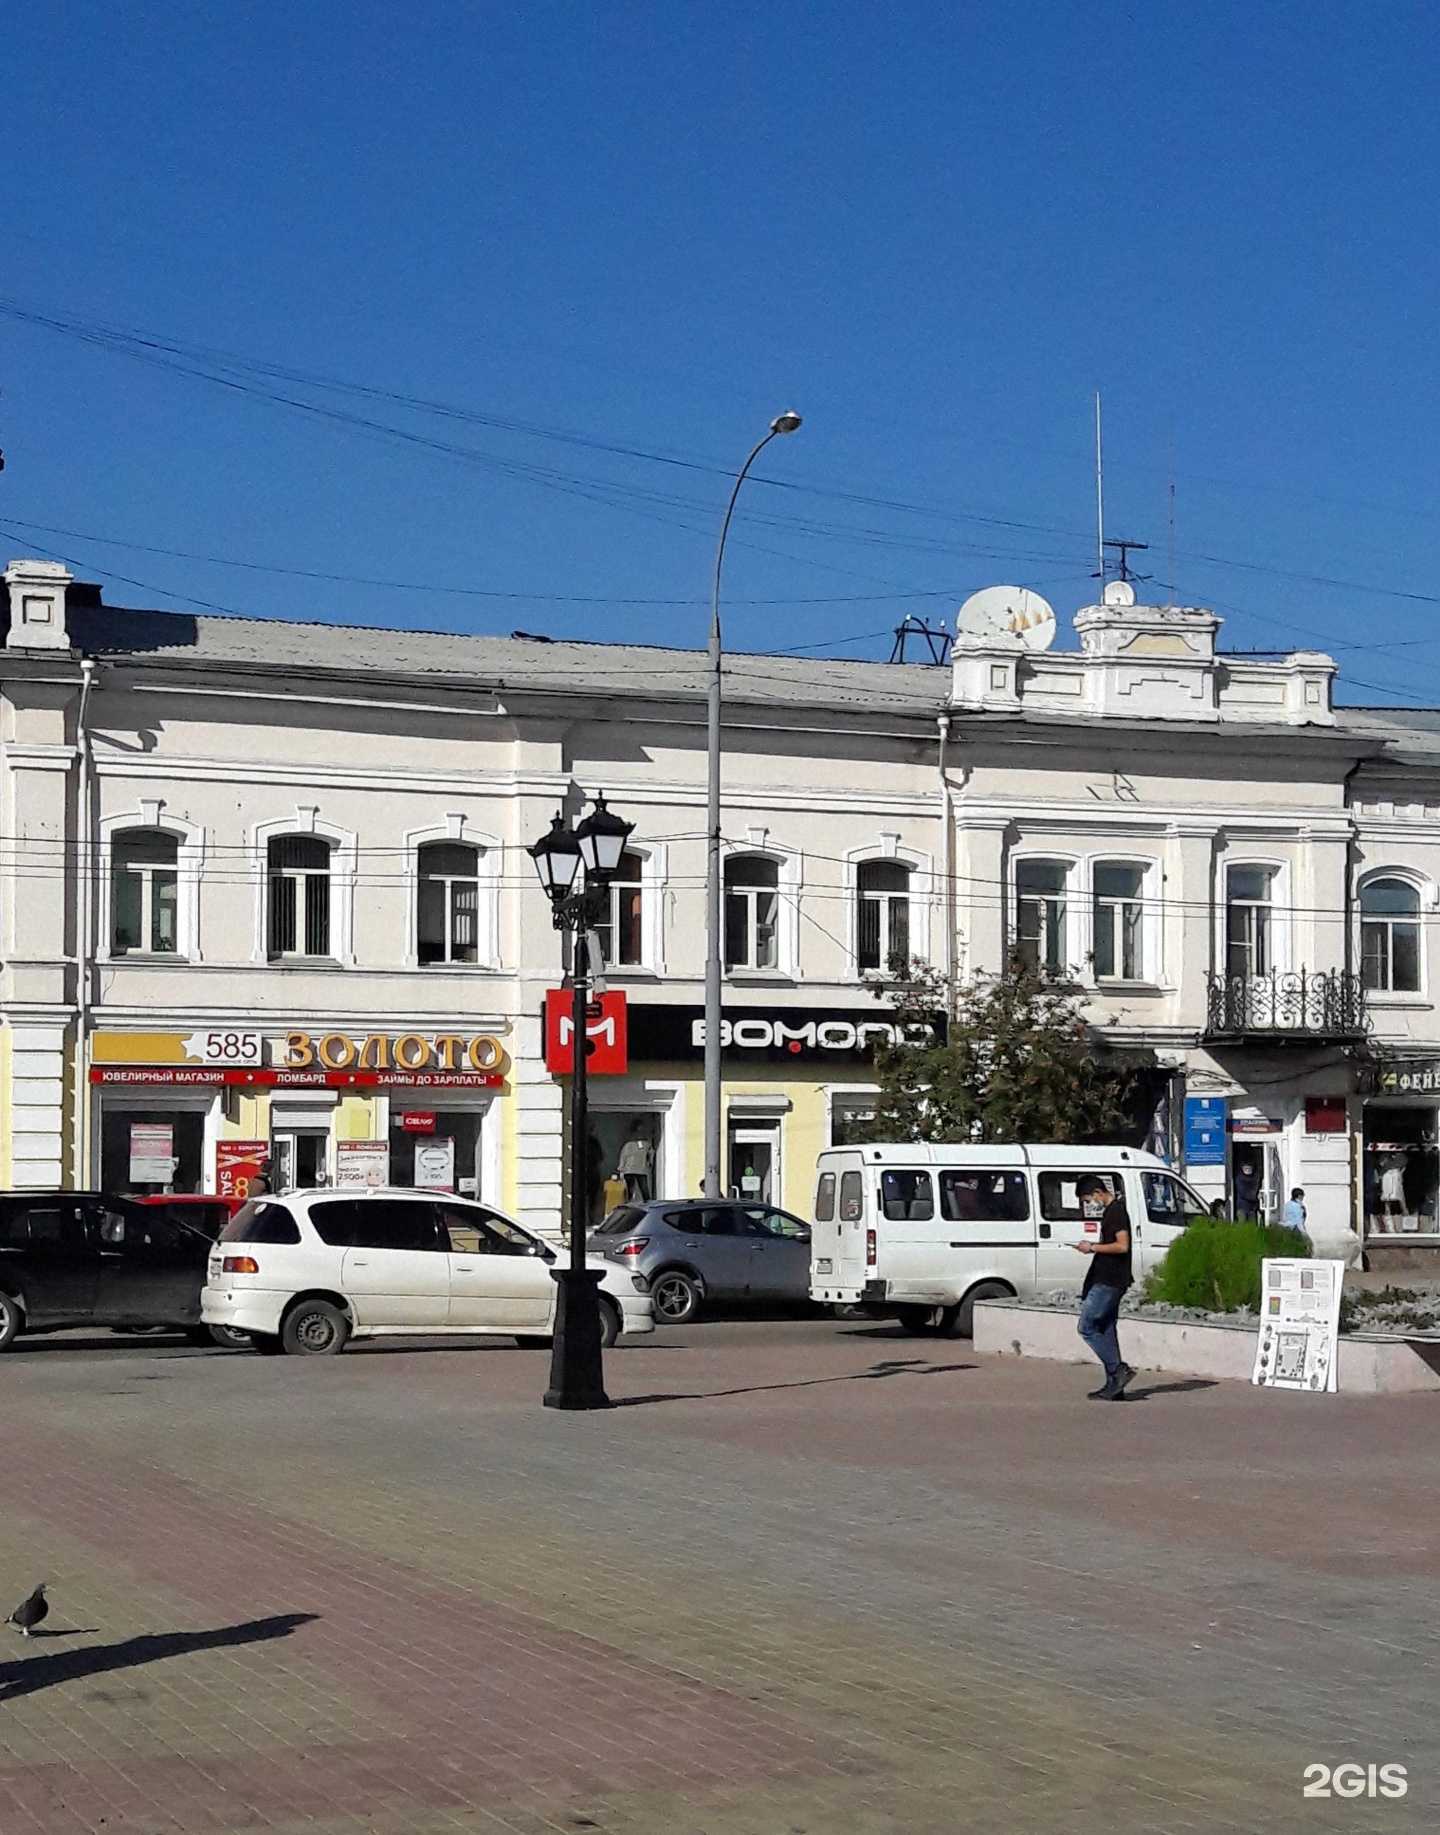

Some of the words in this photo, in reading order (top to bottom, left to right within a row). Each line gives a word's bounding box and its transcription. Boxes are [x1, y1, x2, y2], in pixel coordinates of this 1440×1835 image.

[206, 1033, 257, 1058] 585
[283, 1031, 503, 1070] ЗОЛОТО
[102, 1070, 173, 1082] ЮВЕЛИРНЫЙ
[175, 1072, 225, 1082] МАГАЗИН
[276, 1073, 326, 1083] ЛОМБАРД
[377, 1074, 415, 1084] ЗАЙМЫ
[416, 1075, 432, 1085] ДО
[434, 1075, 487, 1085] ЗАРПЛАТЫ
